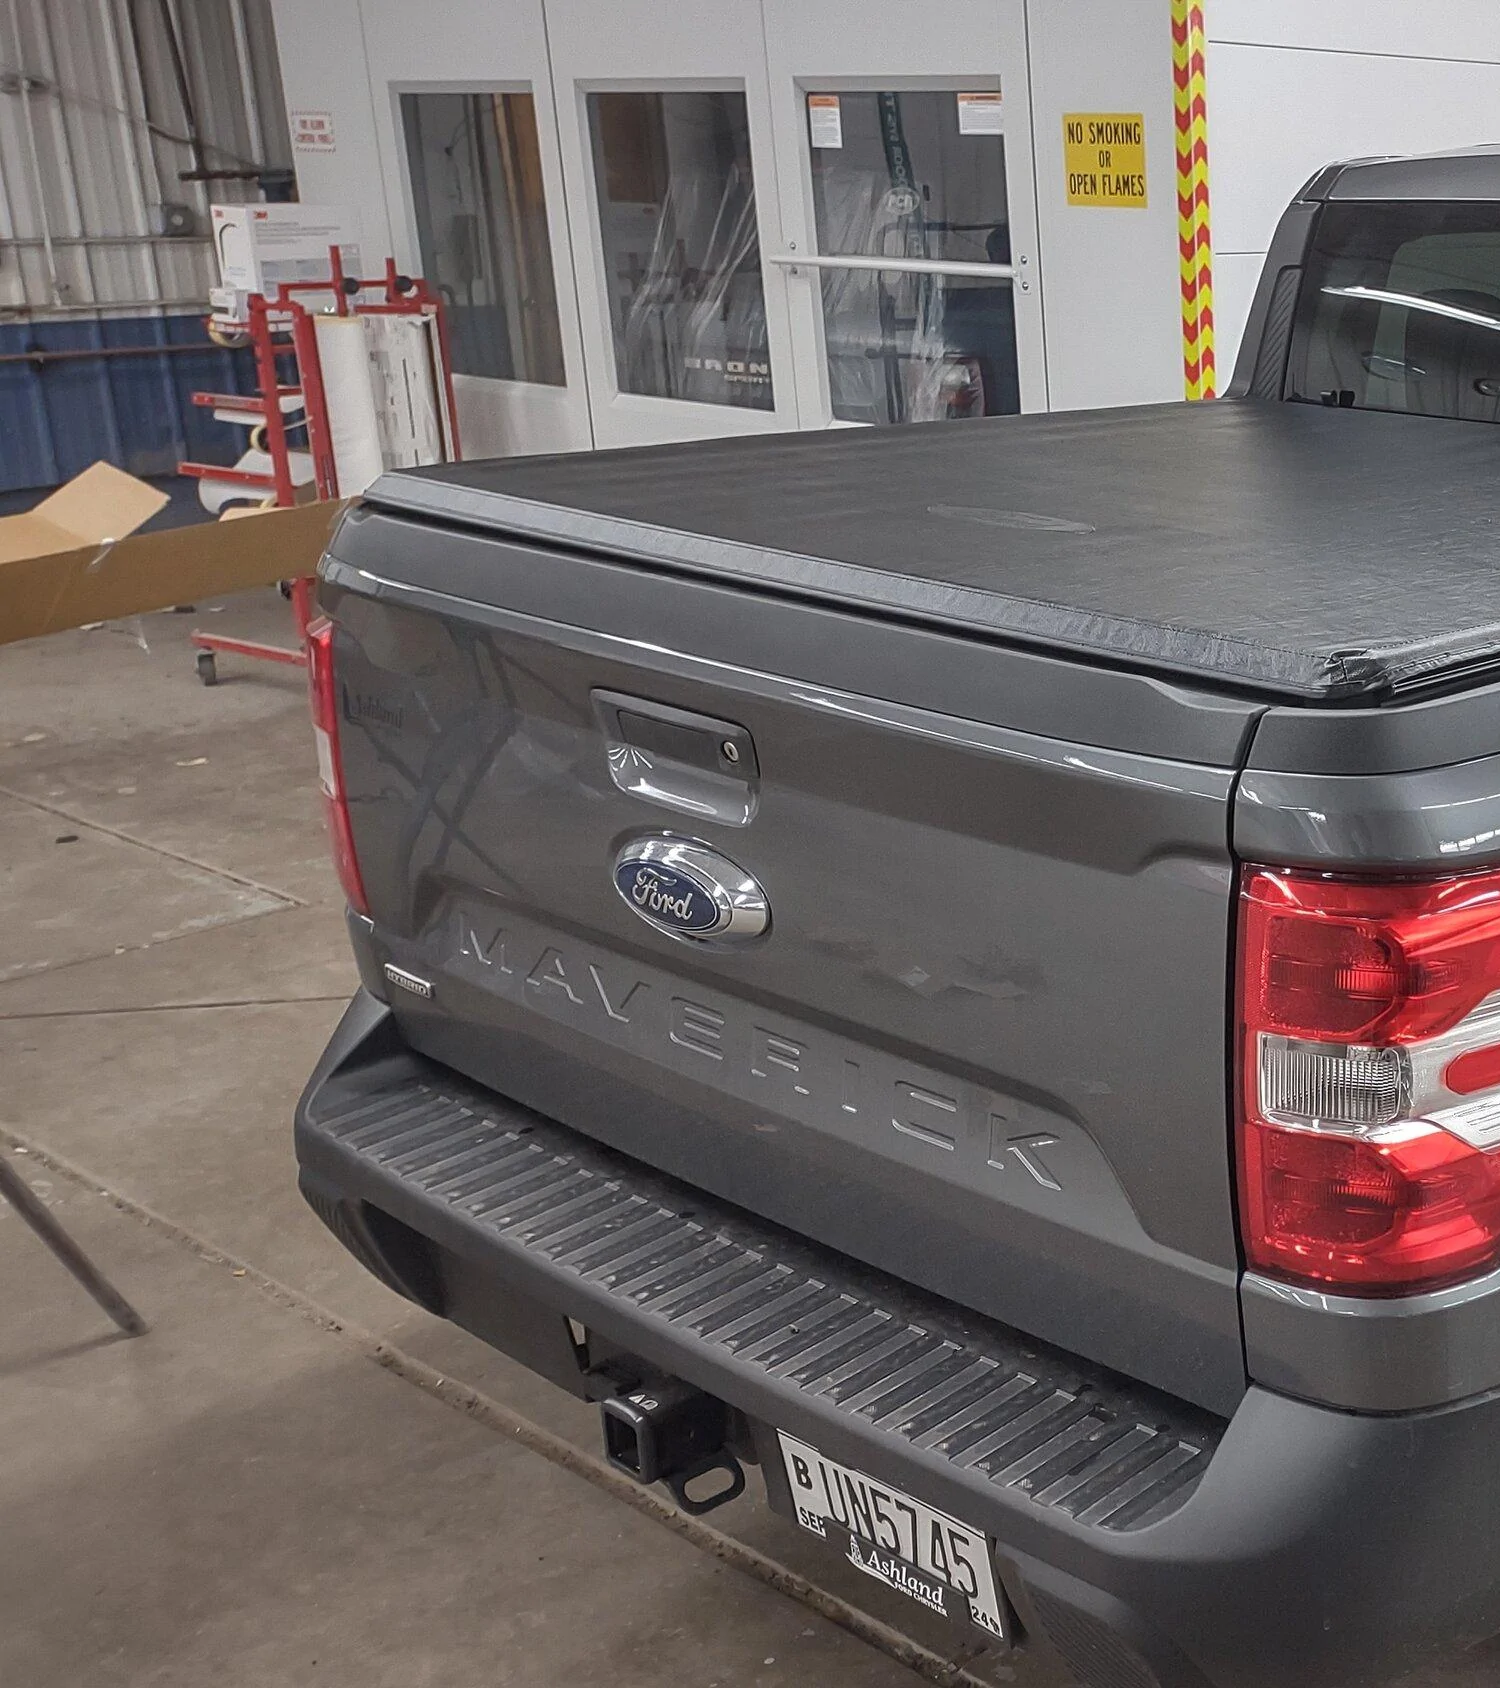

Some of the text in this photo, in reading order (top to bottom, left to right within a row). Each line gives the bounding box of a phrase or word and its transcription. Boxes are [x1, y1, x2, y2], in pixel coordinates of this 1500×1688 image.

[1068, 122, 1141, 145] NO SMOKING
[1099, 150, 1111, 168] OR
[1069, 173, 1145, 197] OPEN FLAMES
[631, 867, 693, 921] Ford
[458, 910, 1062, 1192] MAVERICK
[791, 1453, 978, 1598] B UN5745
[866, 1551, 944, 1606] Ashland
